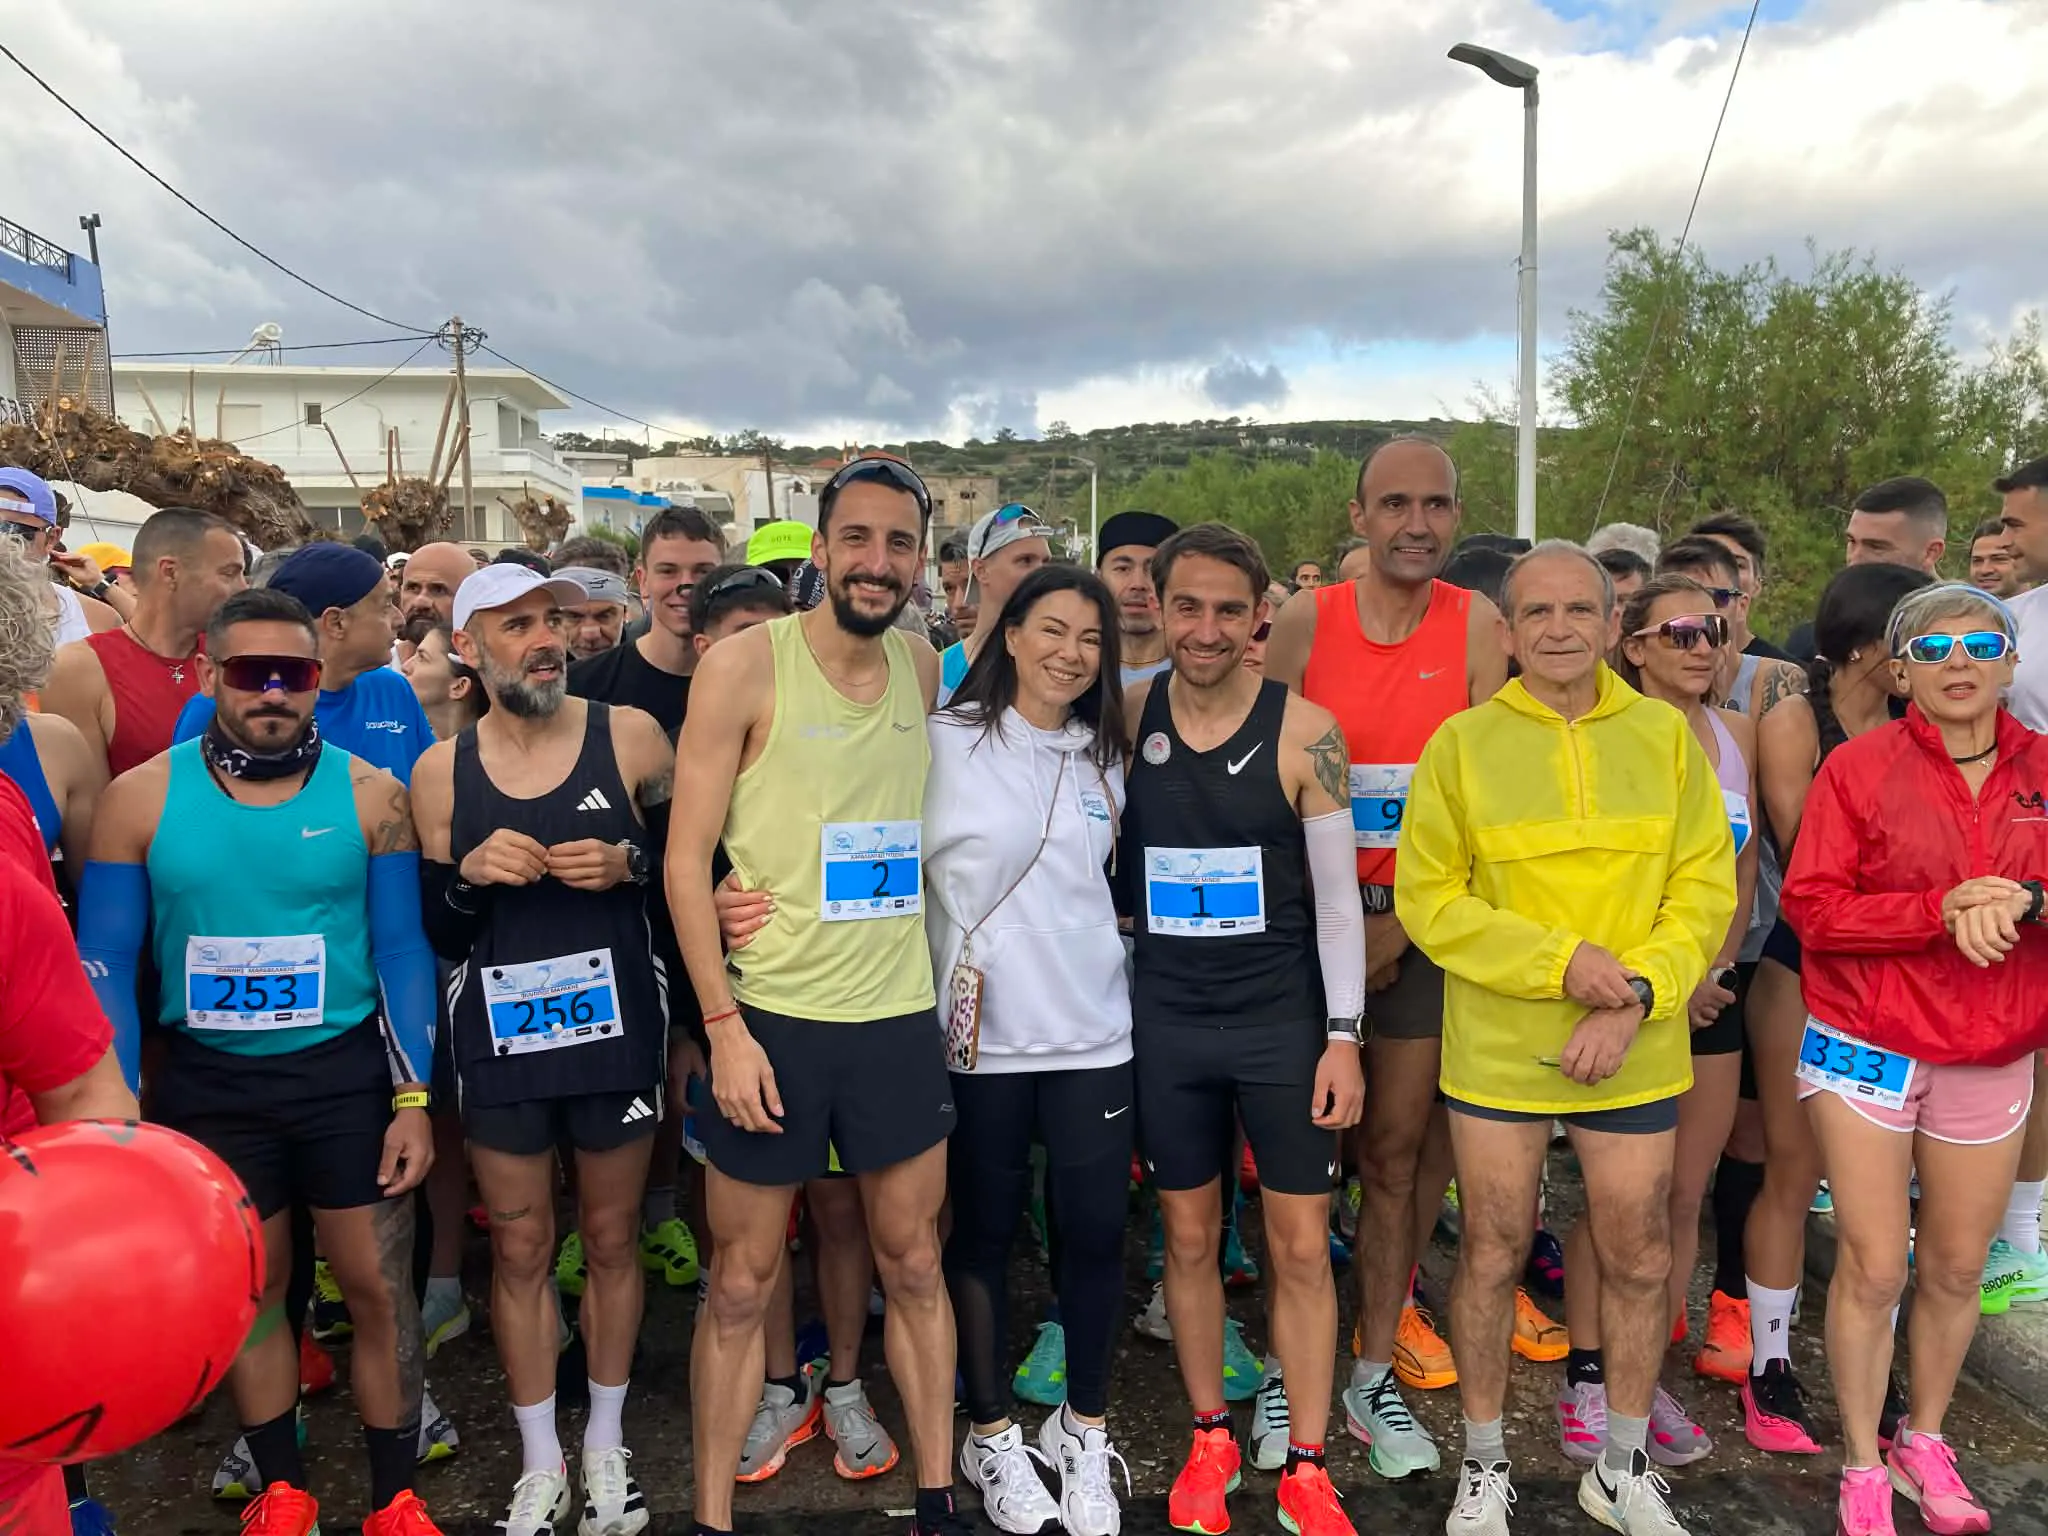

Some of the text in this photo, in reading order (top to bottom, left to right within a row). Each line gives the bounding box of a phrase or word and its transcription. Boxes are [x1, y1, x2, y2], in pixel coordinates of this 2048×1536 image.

[1381, 799, 1403, 830] 9
[872, 861, 890, 897] 2
[1191, 885, 1213, 918] 1
[214, 975, 297, 1011] 253
[513, 990, 594, 1034] 256
[1810, 1033, 1887, 1084] 333
[1982, 1269, 2024, 1294] BROOKS
